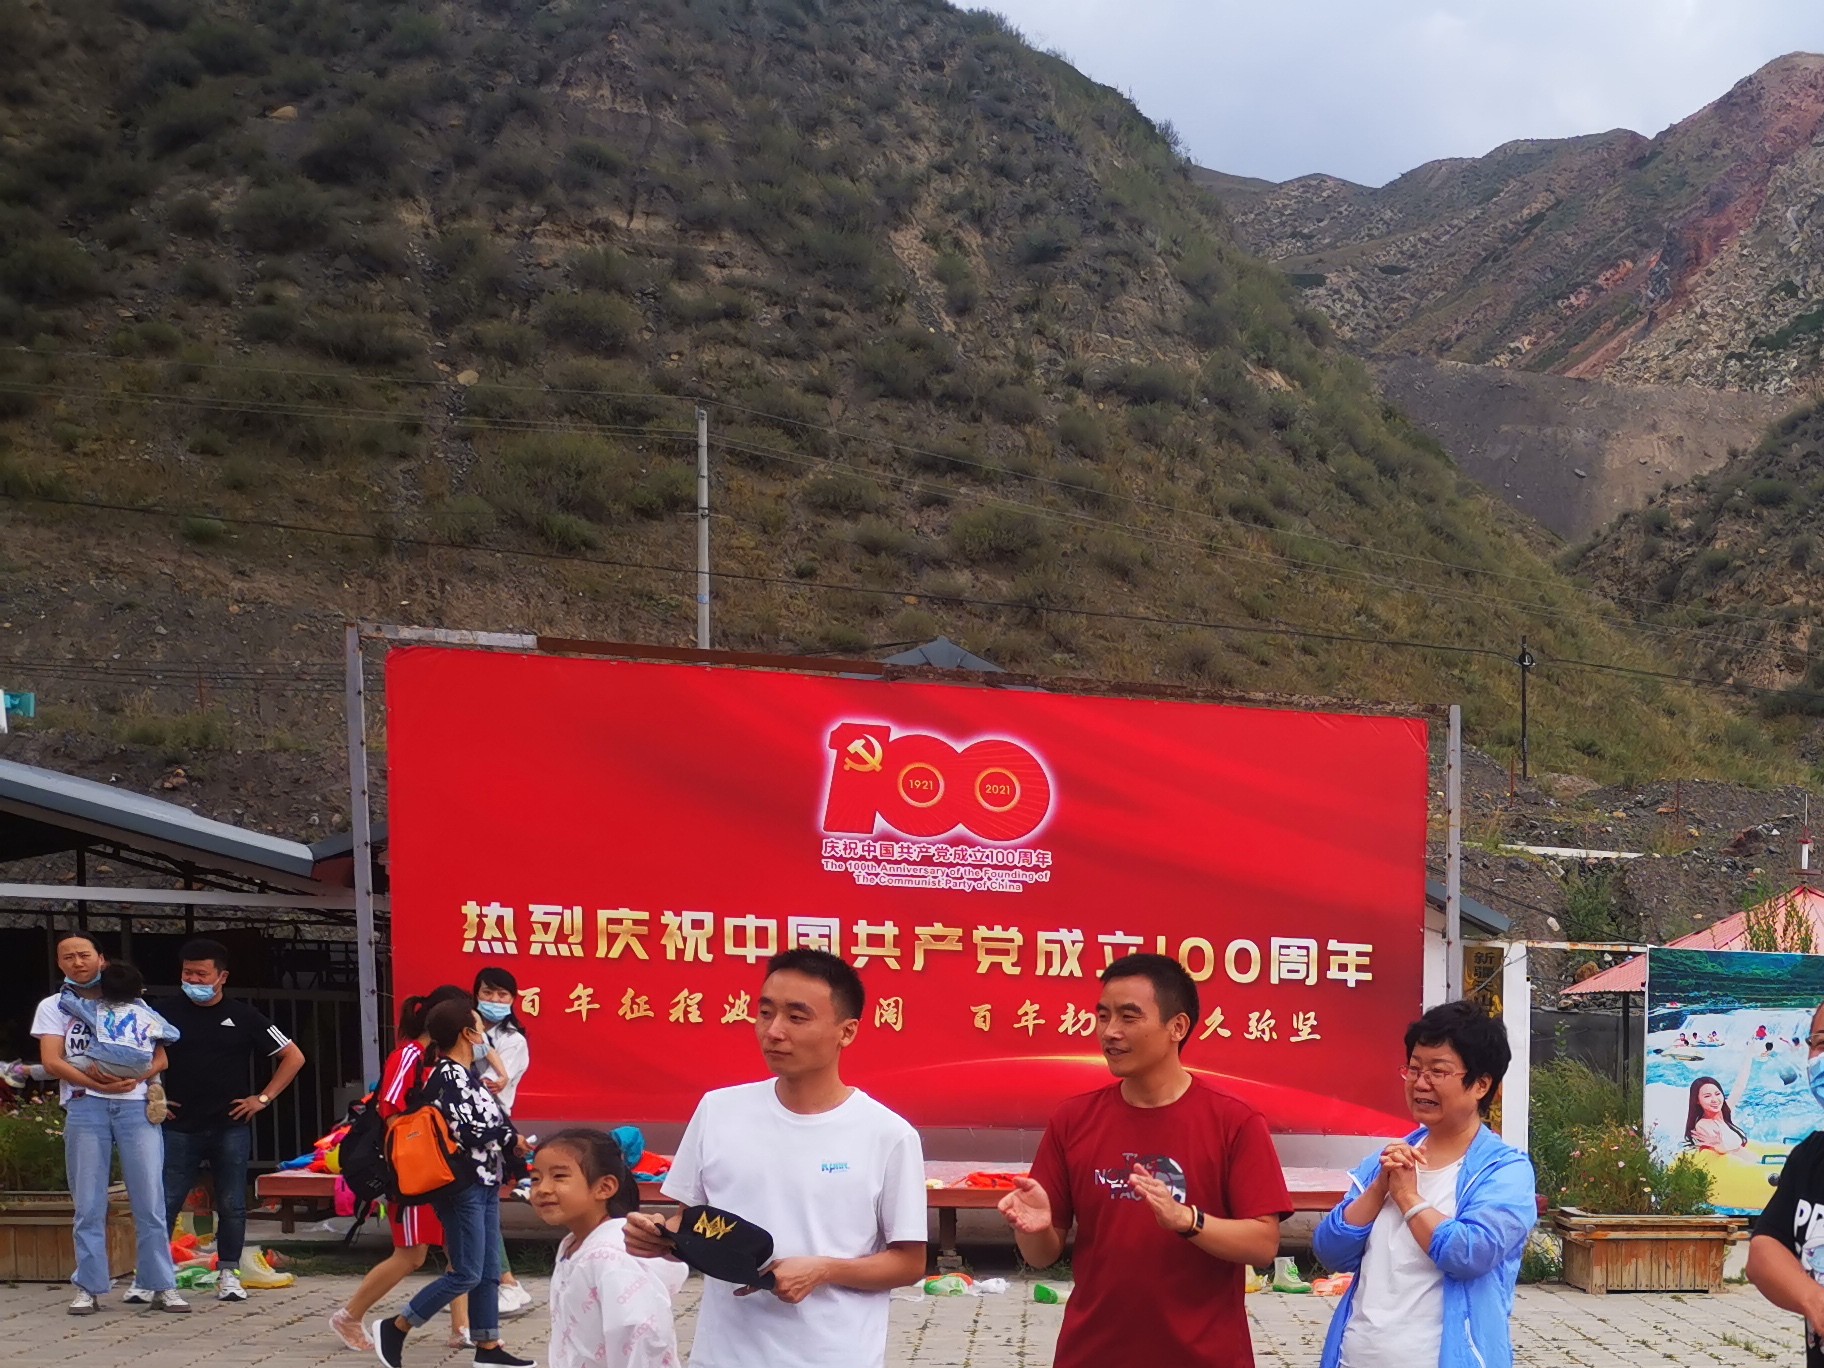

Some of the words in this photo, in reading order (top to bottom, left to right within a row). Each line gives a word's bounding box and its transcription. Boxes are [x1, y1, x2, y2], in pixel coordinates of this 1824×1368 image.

[908, 778, 934, 791] 1921
[984, 783, 1011, 796] 2021
[823, 840, 1052, 867] 庆祝中国共产党成立100周年
[823, 860, 844, 871] The
[847, 861, 878, 873] 100th
[880, 863, 947, 877] Anniversary
[949, 867, 961, 876] of
[963, 867, 981, 877] the
[983, 868, 1034, 881] Founding
[1036, 872, 1049, 881] of
[855, 874, 875, 884] The
[878, 875, 942, 888] Communist
[944, 880, 973, 891] Party
[976, 880, 988, 890] of
[990, 881, 1021, 892] China
